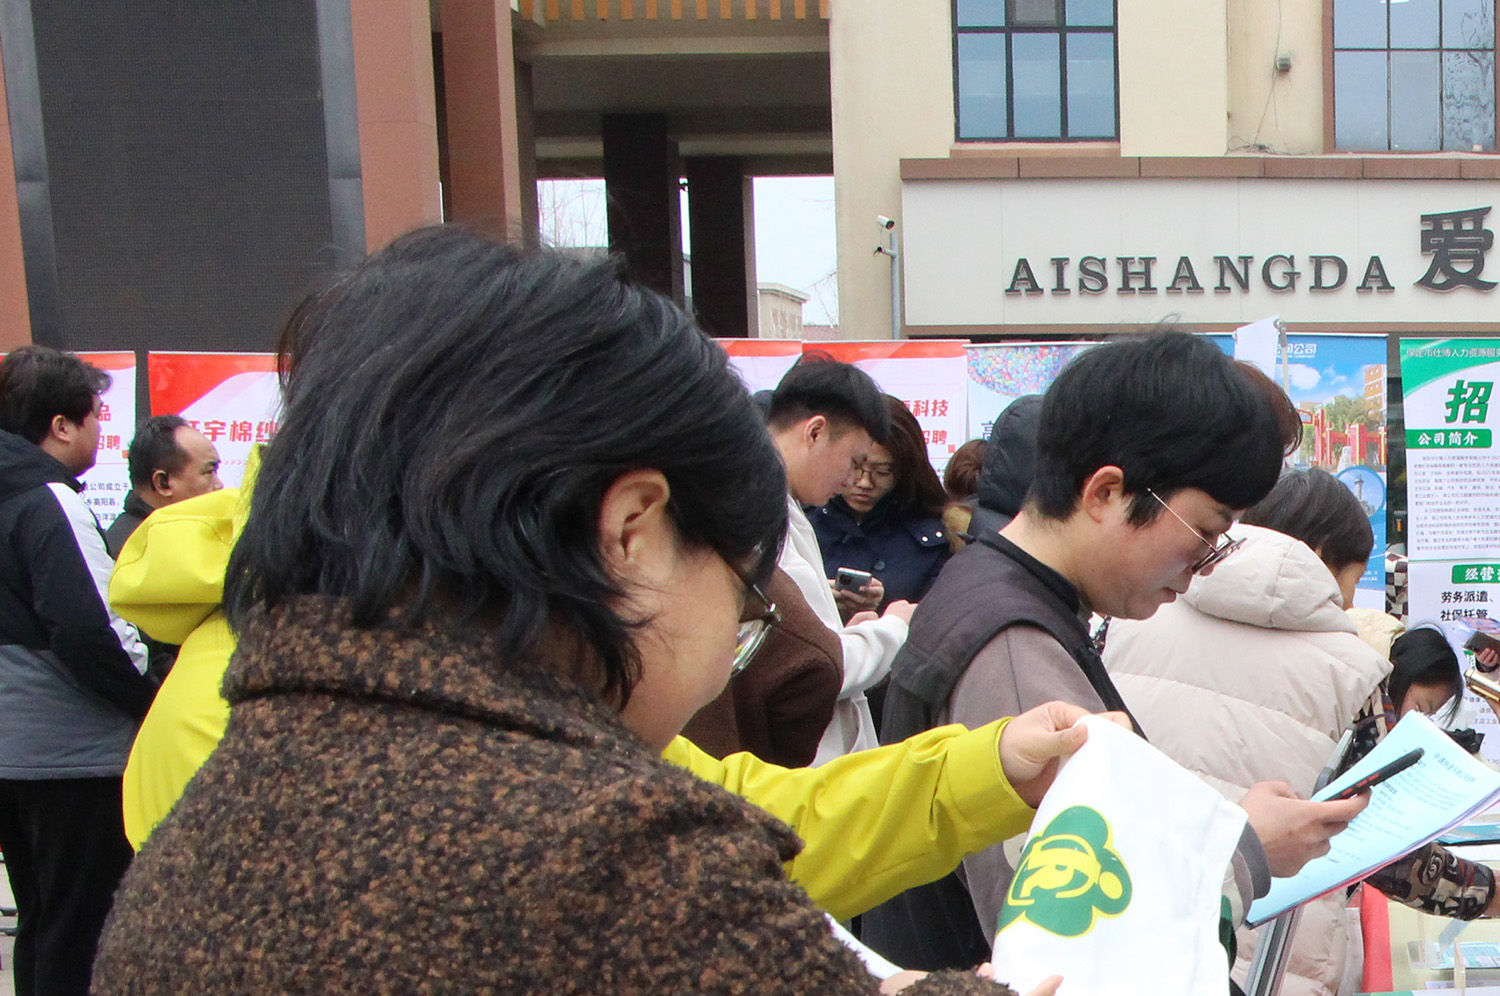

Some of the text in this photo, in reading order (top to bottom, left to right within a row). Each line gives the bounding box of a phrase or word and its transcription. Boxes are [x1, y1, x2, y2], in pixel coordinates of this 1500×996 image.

[1003, 254, 1396, 296] AISHANGDA
[1418, 431, 1479, 447] 公司简介
